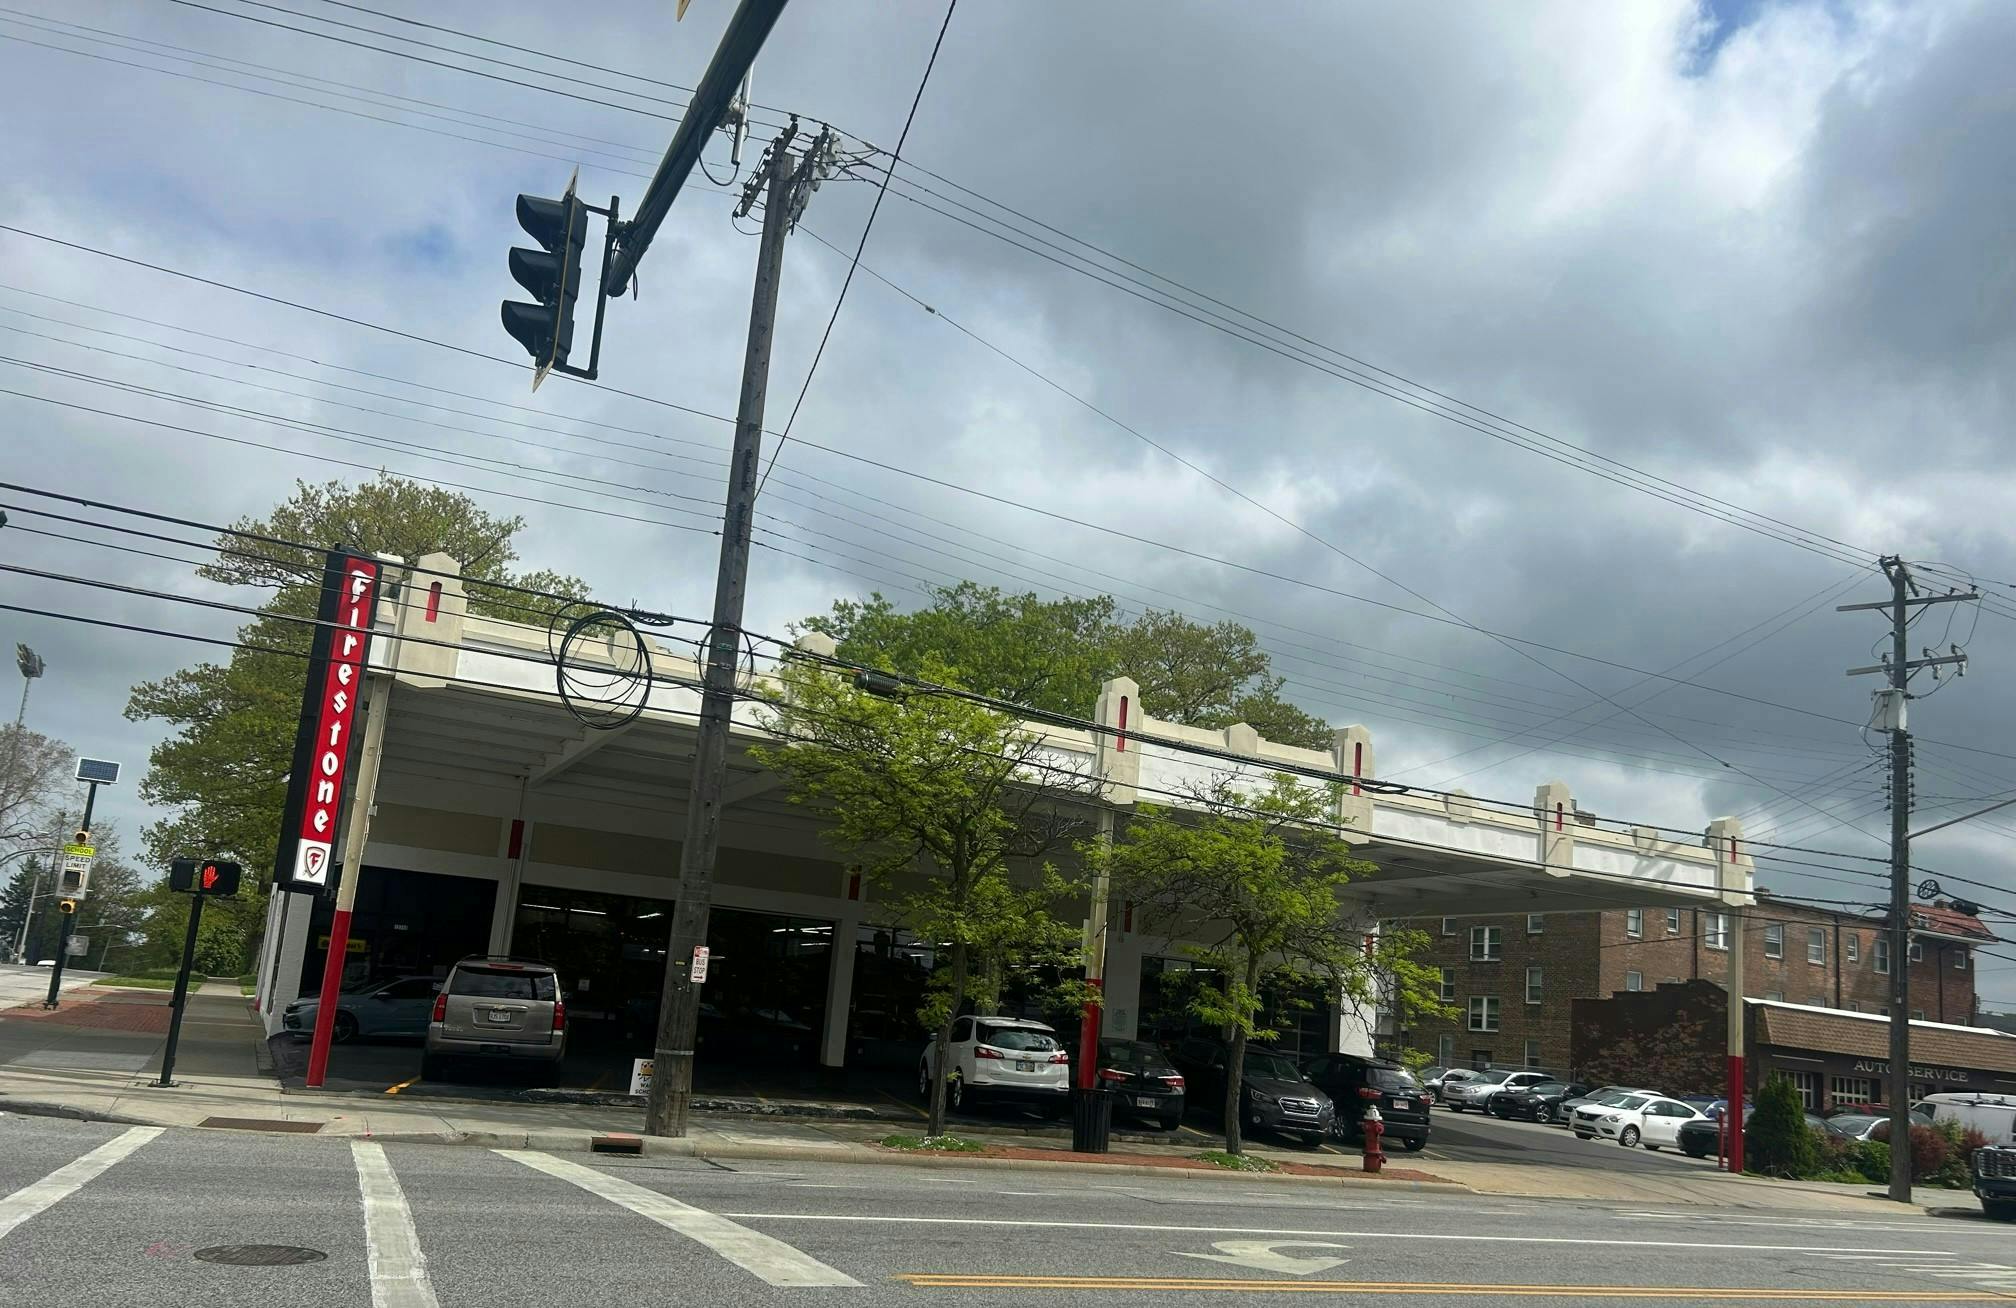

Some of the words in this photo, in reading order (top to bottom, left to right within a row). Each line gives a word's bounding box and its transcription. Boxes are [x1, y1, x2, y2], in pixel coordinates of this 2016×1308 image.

[313, 569, 374, 834] Firestone
[66, 846, 92, 855] SCHOOL
[65, 854, 91, 863] SPEED
[695, 958, 706, 966] BUS
[693, 966, 706, 975] STOP
[1907, 1065, 1969, 1083] SERVICE
